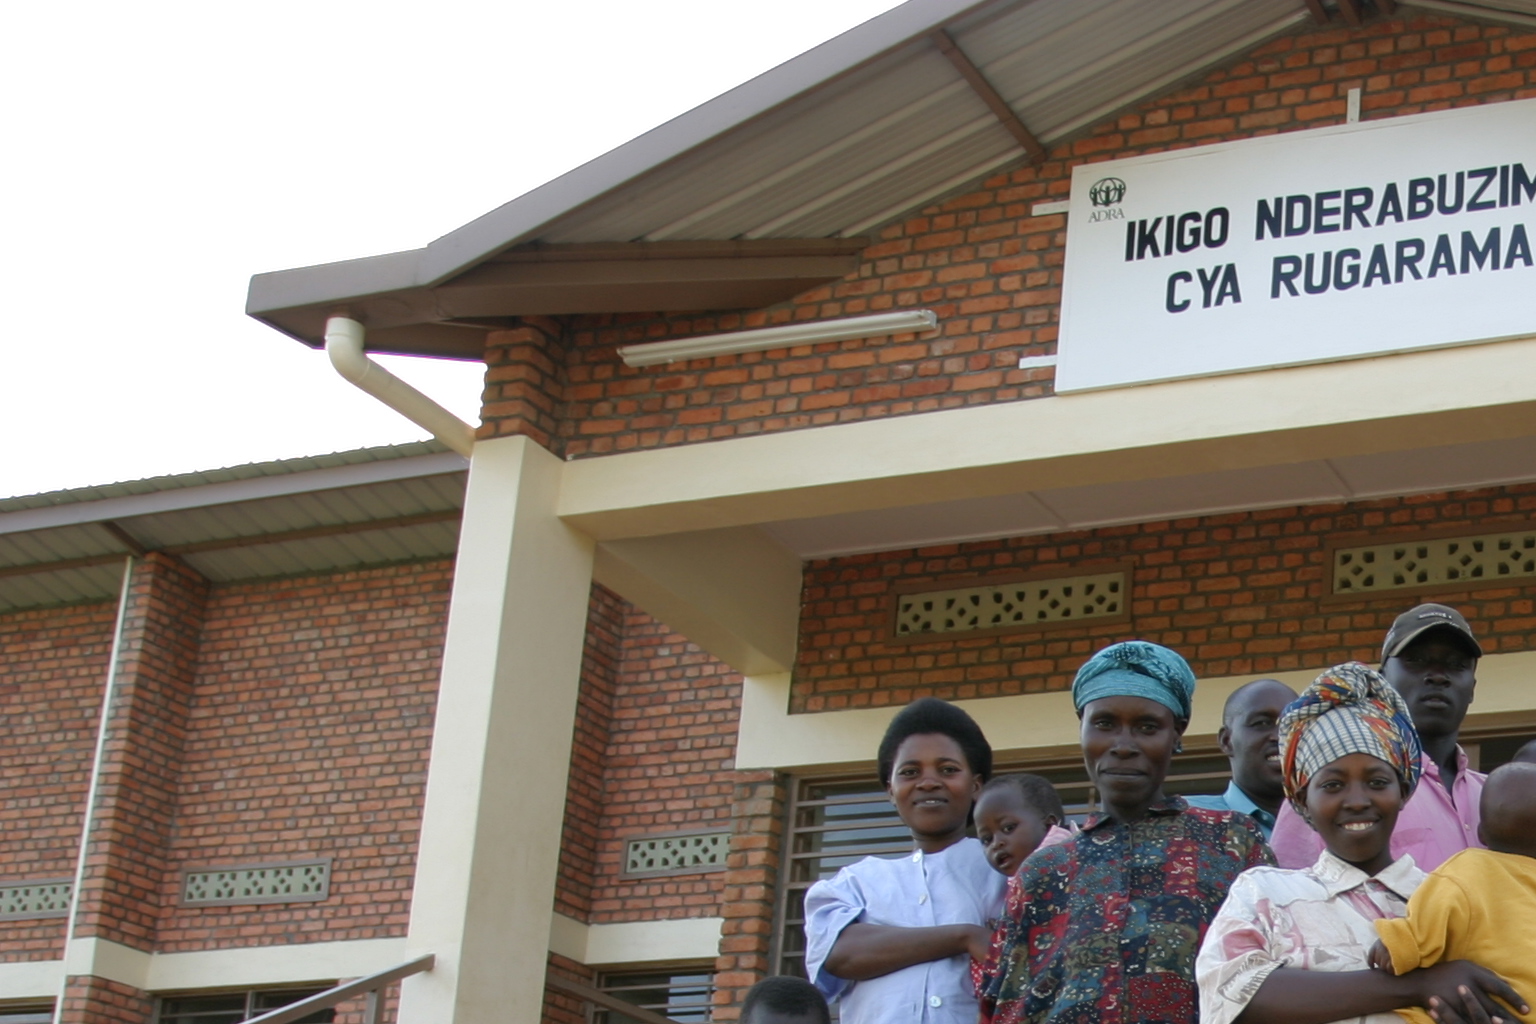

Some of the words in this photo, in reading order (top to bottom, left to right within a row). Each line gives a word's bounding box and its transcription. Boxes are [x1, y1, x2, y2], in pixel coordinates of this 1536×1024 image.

[1088, 207, 1126, 223] ADRA
[1125, 206, 1230, 262] IKIGO
[1165, 263, 1242, 314] CYA
[1271, 223, 1534, 299] RUGARAMA
